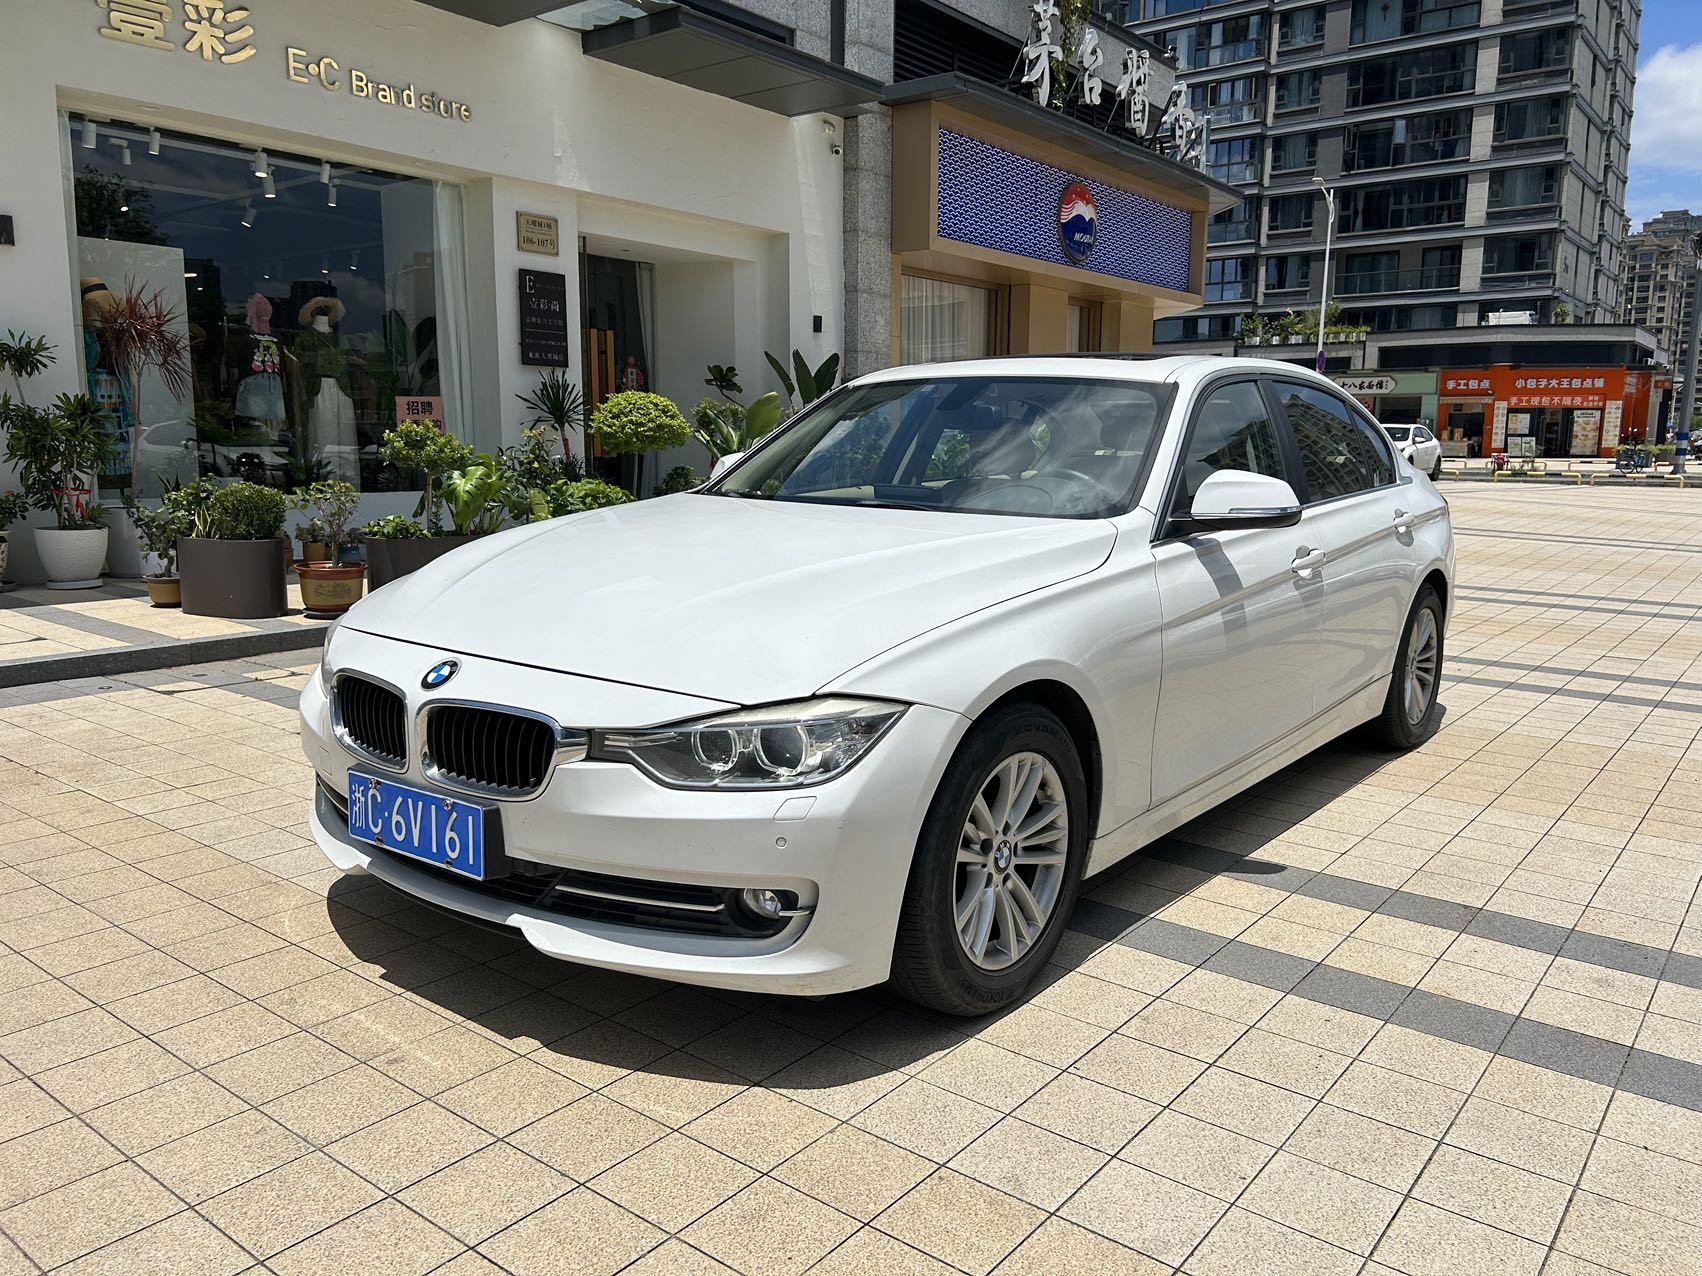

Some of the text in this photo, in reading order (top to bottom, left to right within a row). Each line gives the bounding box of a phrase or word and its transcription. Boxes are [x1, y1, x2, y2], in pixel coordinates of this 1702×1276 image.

[350, 70, 416, 109] Brand
[420, 92, 472, 123] store
[525, 275, 535, 294] E
[1446, 379, 1491, 390] 手工包点
[406, 400, 434, 416] 招聘
[1509, 396, 1582, 406] 手工现包不隔夜
